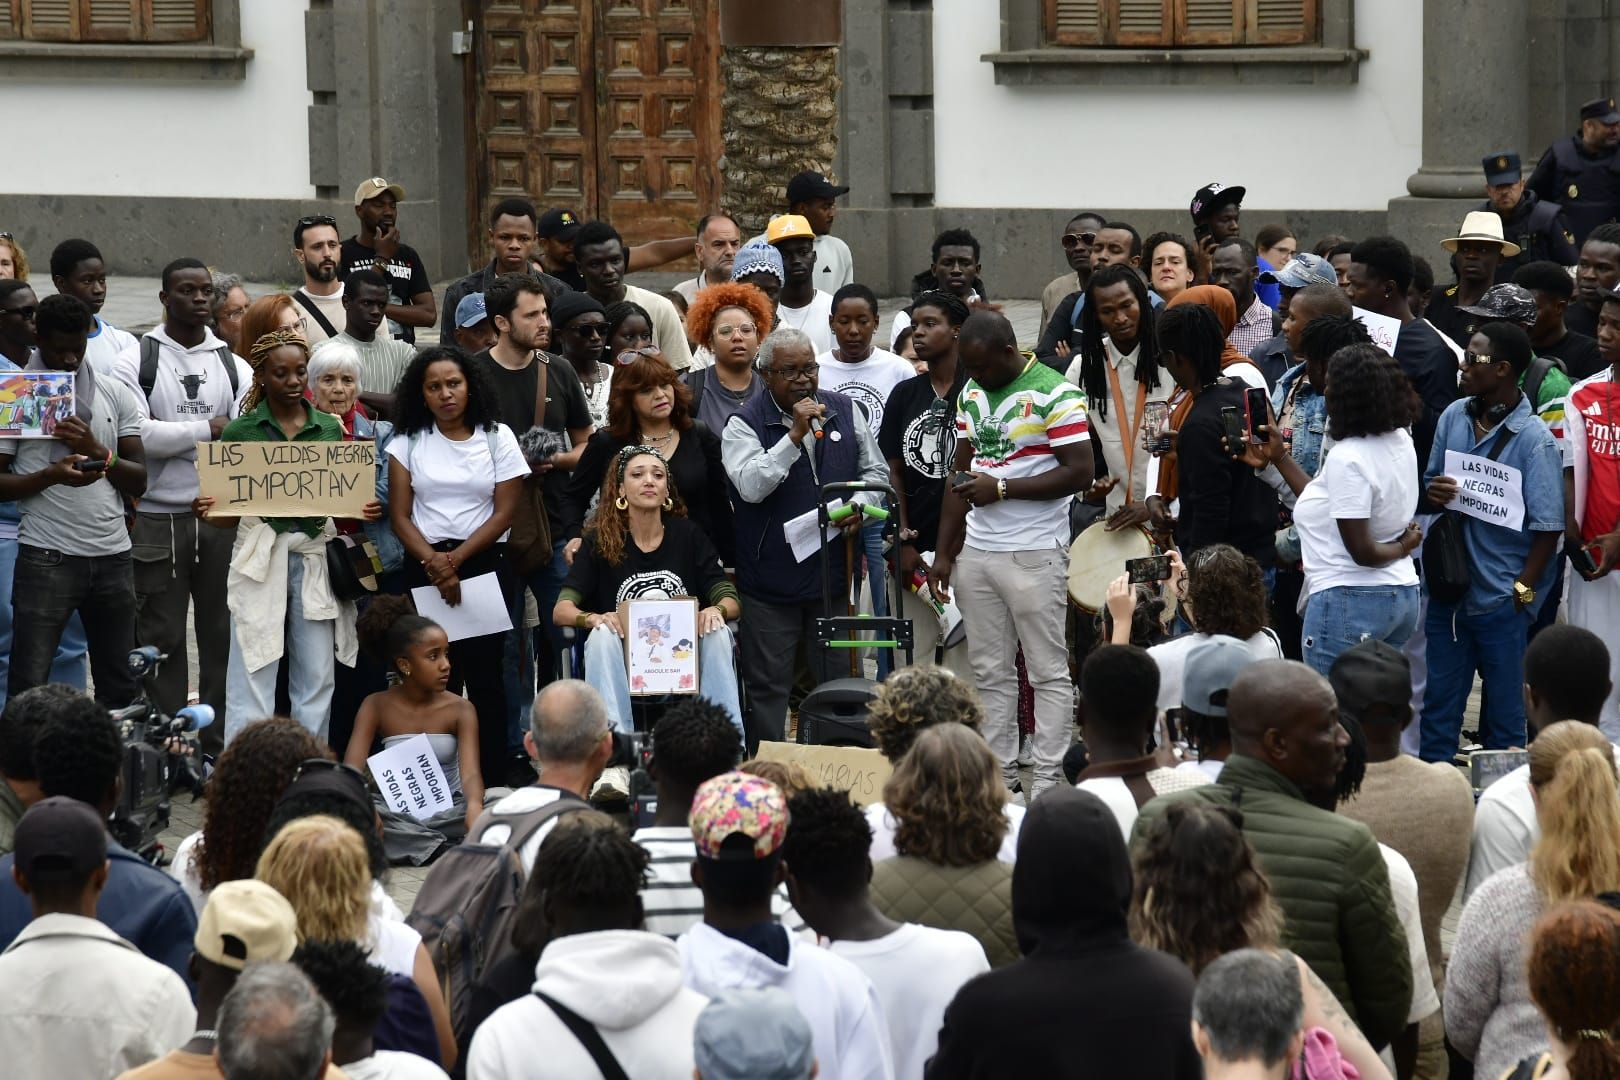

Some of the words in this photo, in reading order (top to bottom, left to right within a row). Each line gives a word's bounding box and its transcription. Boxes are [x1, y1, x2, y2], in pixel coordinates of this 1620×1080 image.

[208, 443, 244, 468] LAS
[261, 445, 320, 466] VIDAS
[326, 444, 374, 466] NEGRAS
[1462, 460, 1481, 473] LAS
[1483, 464, 1509, 482] VIDAS
[228, 468, 360, 504] IMPORTAN
[1462, 478, 1505, 498] NEGRAS
[1459, 494, 1508, 519] IMPORTAN
[382, 769, 402, 800] VIDAS
[401, 767, 427, 809] NEGRAS
[416, 753, 445, 804] IMPORTAN
